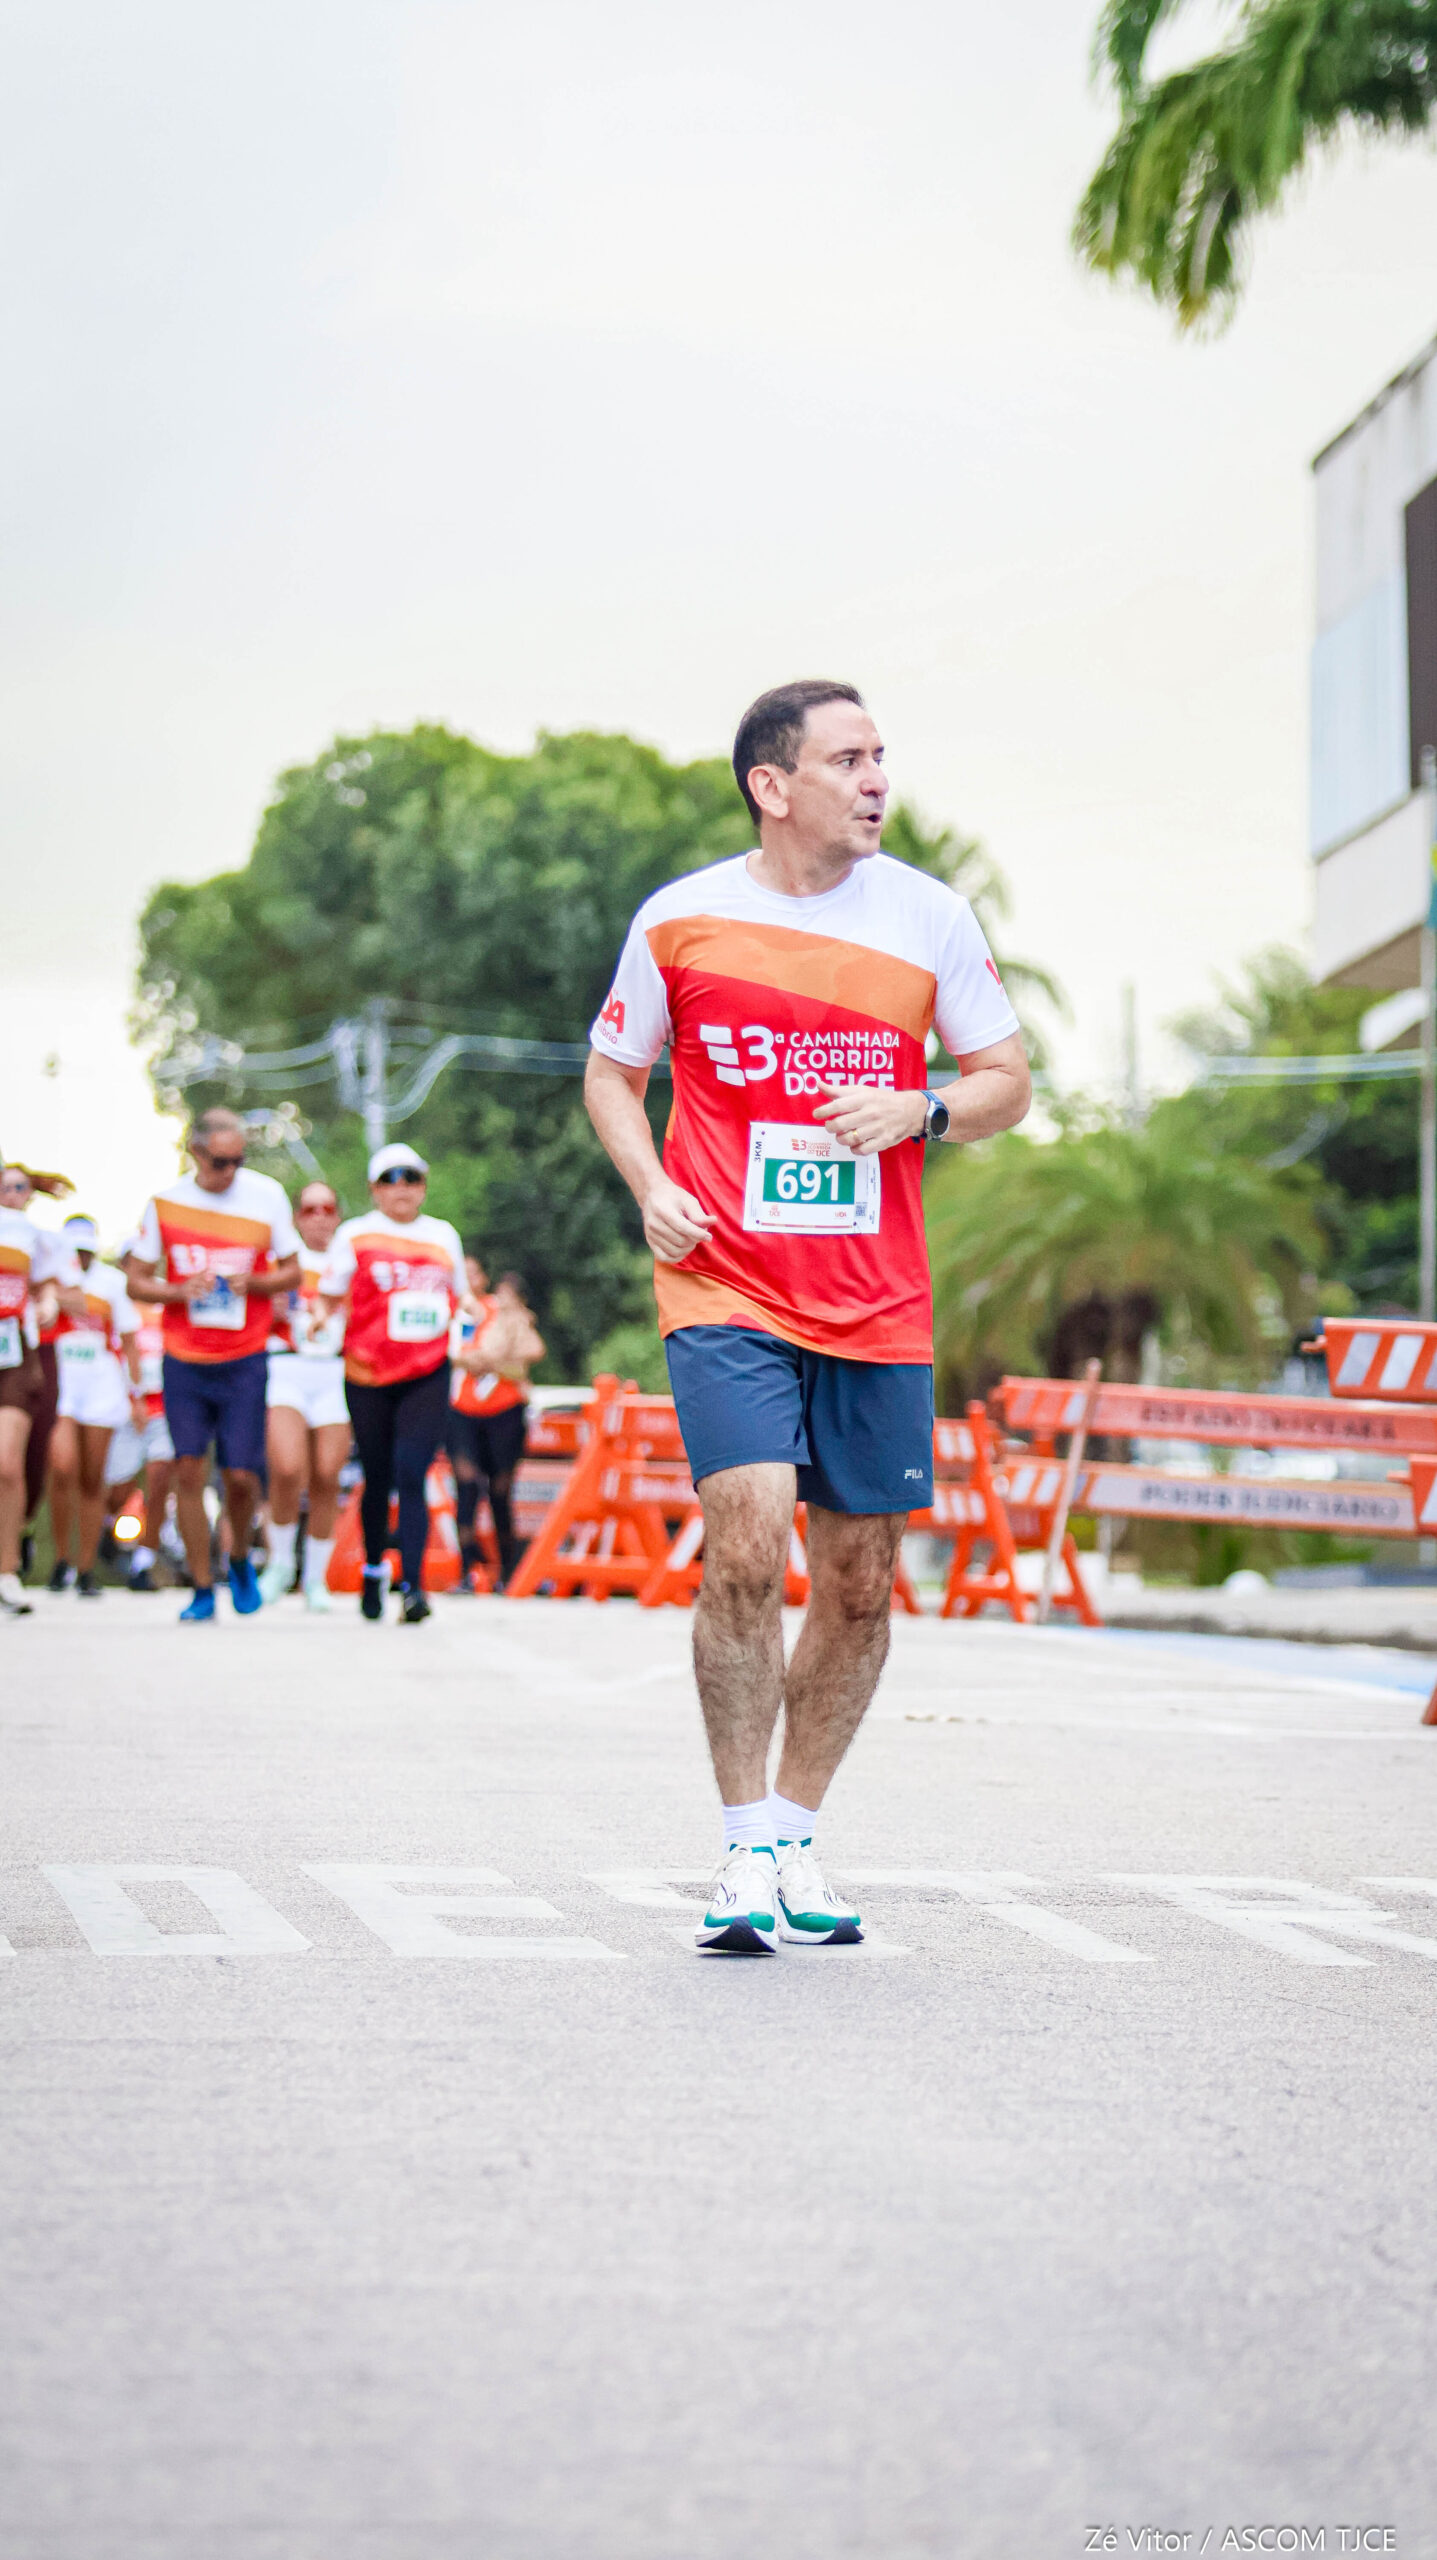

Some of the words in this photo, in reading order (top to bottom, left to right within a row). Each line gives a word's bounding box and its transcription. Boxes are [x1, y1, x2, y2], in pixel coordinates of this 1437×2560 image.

[790, 1031, 900, 1048] CAMINHADA
[785, 1071, 820, 1096] DO
[776, 1162, 840, 1202] 691
[904, 1468, 924, 1480] FILA
[0, 1862, 1437, 1967] DESTR
